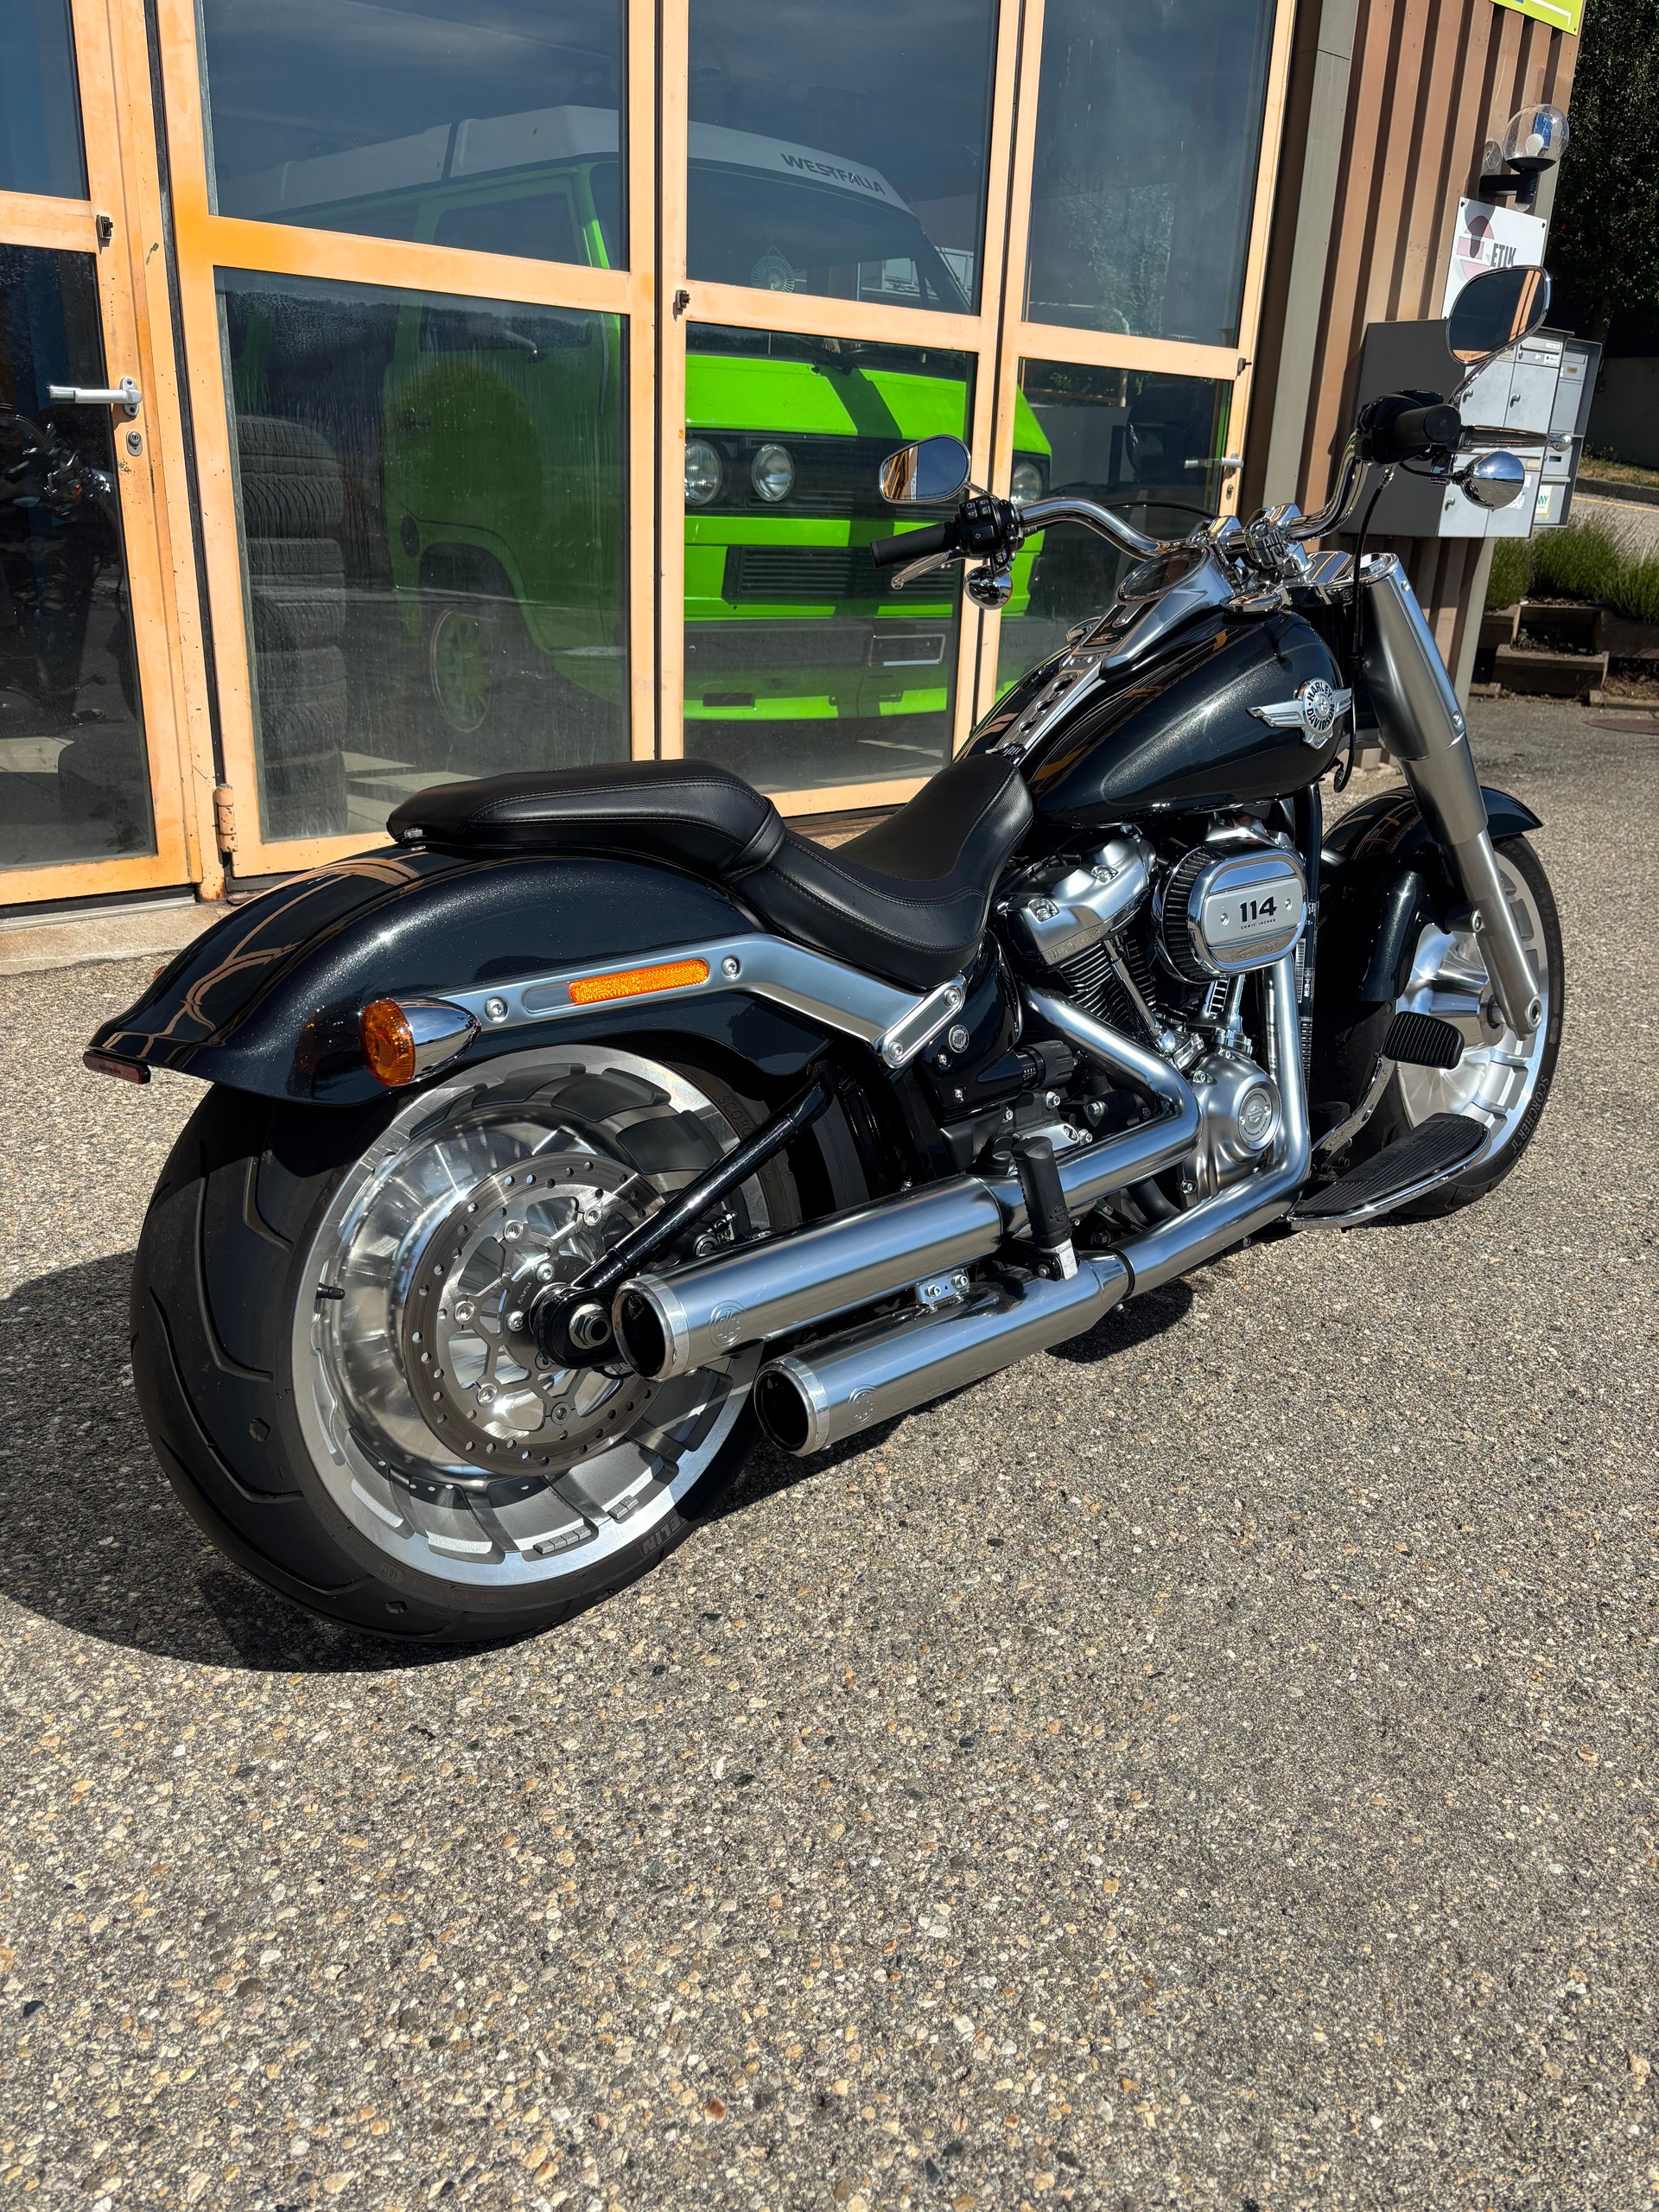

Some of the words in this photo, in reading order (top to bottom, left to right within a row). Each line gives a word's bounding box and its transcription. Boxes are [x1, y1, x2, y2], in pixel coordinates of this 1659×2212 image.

[781, 153, 886, 194] WESTFALIA
[1491, 243, 1517, 269] ETIK
[1240, 896, 1277, 923] 114
[1518, 1075, 1549, 1141] SCORCHER
